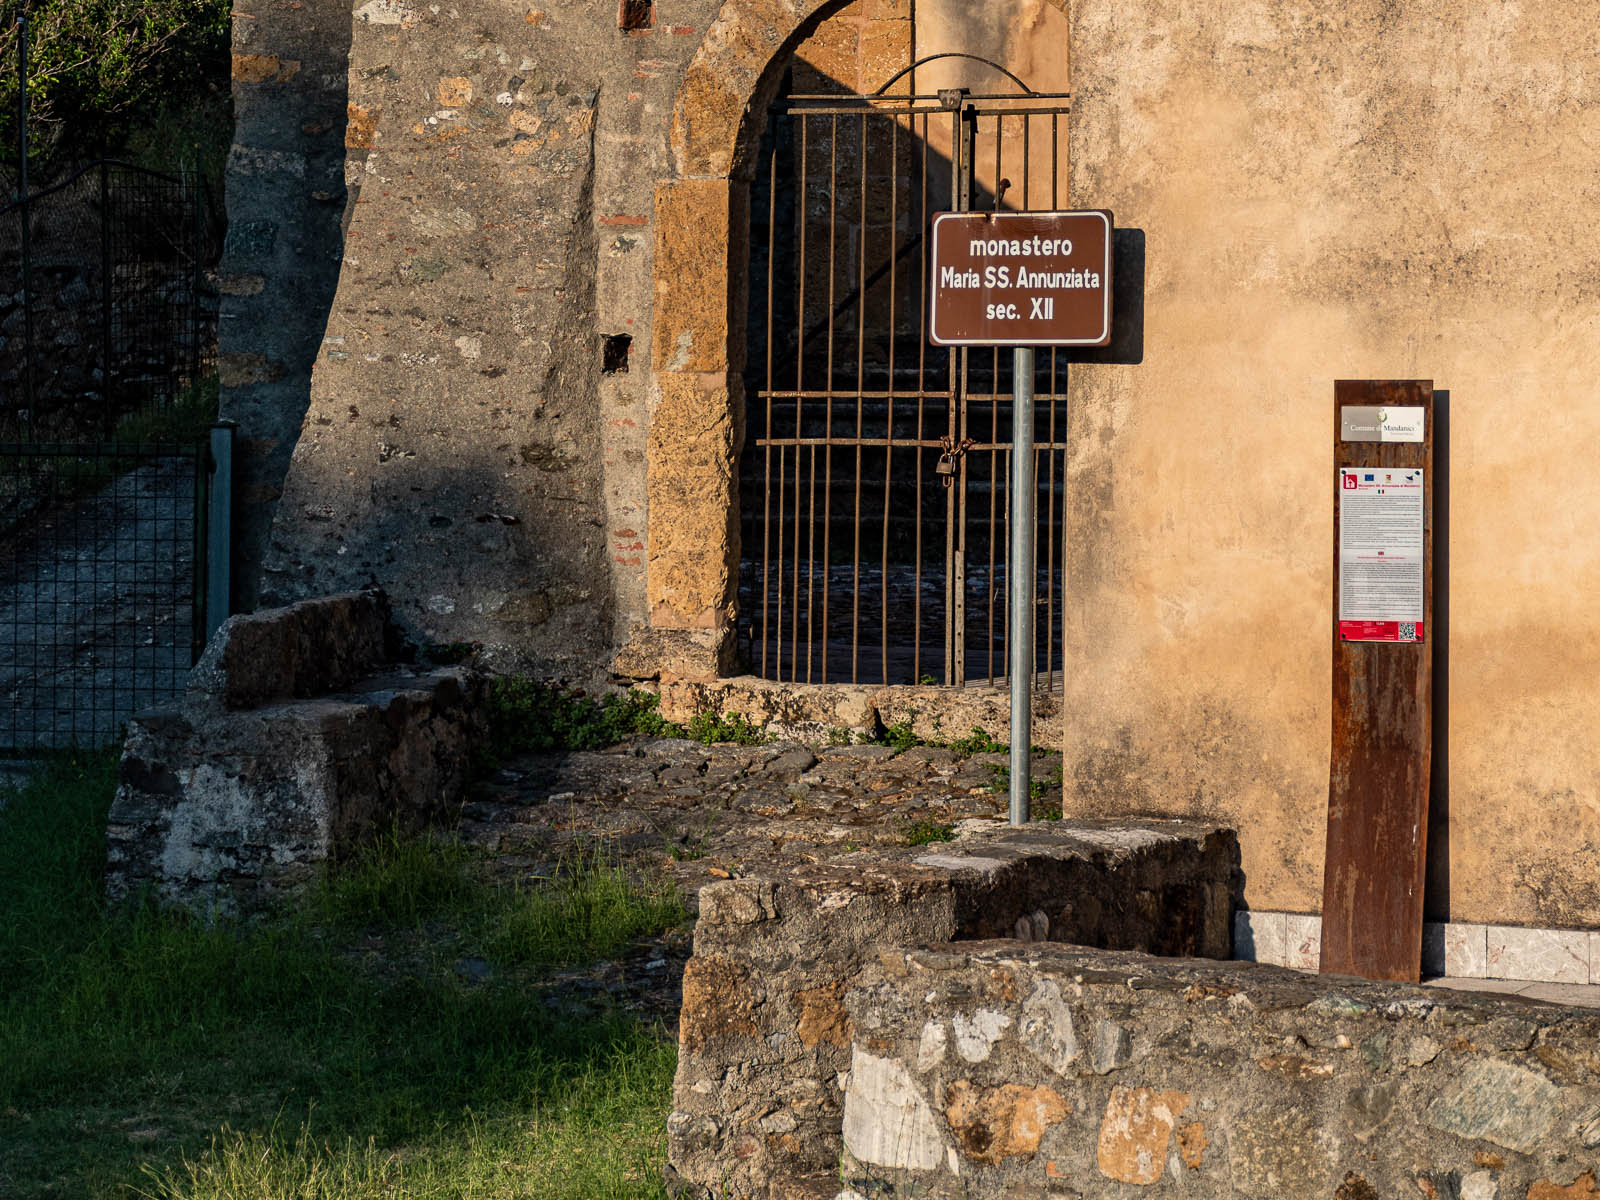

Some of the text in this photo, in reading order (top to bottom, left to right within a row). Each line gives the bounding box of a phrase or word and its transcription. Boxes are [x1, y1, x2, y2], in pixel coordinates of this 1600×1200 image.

[969, 235, 1073, 256] monastero
[940, 266, 1100, 289] Maria SS. Annunziata
[986, 297, 1054, 320] sec. XII
